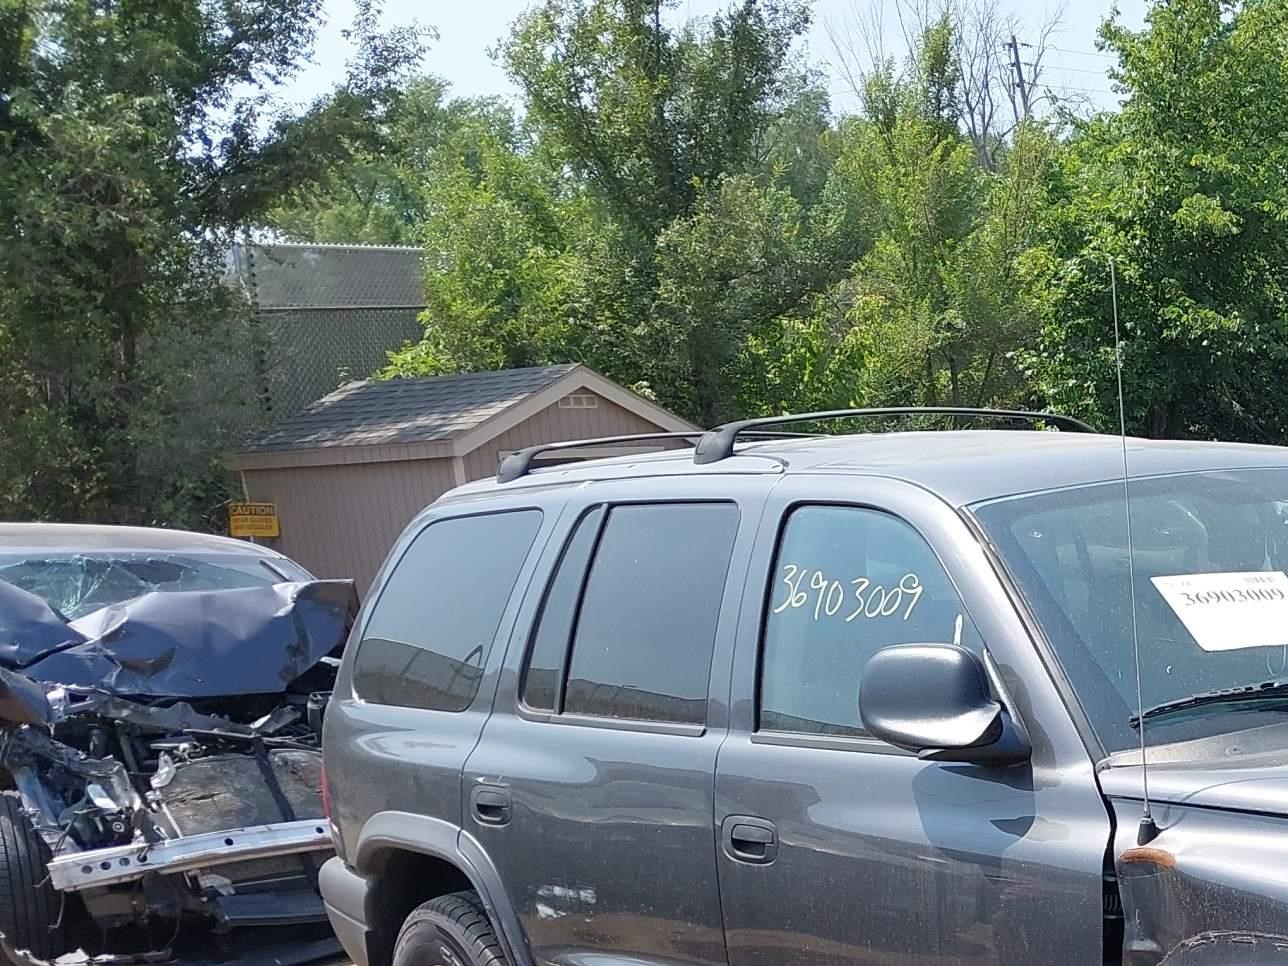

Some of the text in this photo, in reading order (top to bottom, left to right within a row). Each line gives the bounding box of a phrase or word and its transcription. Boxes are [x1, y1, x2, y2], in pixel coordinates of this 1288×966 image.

[231, 505, 274, 515] CAUTION
[774, 564, 923, 622] 36903009
[1181, 588, 1285, 607] 36903009
